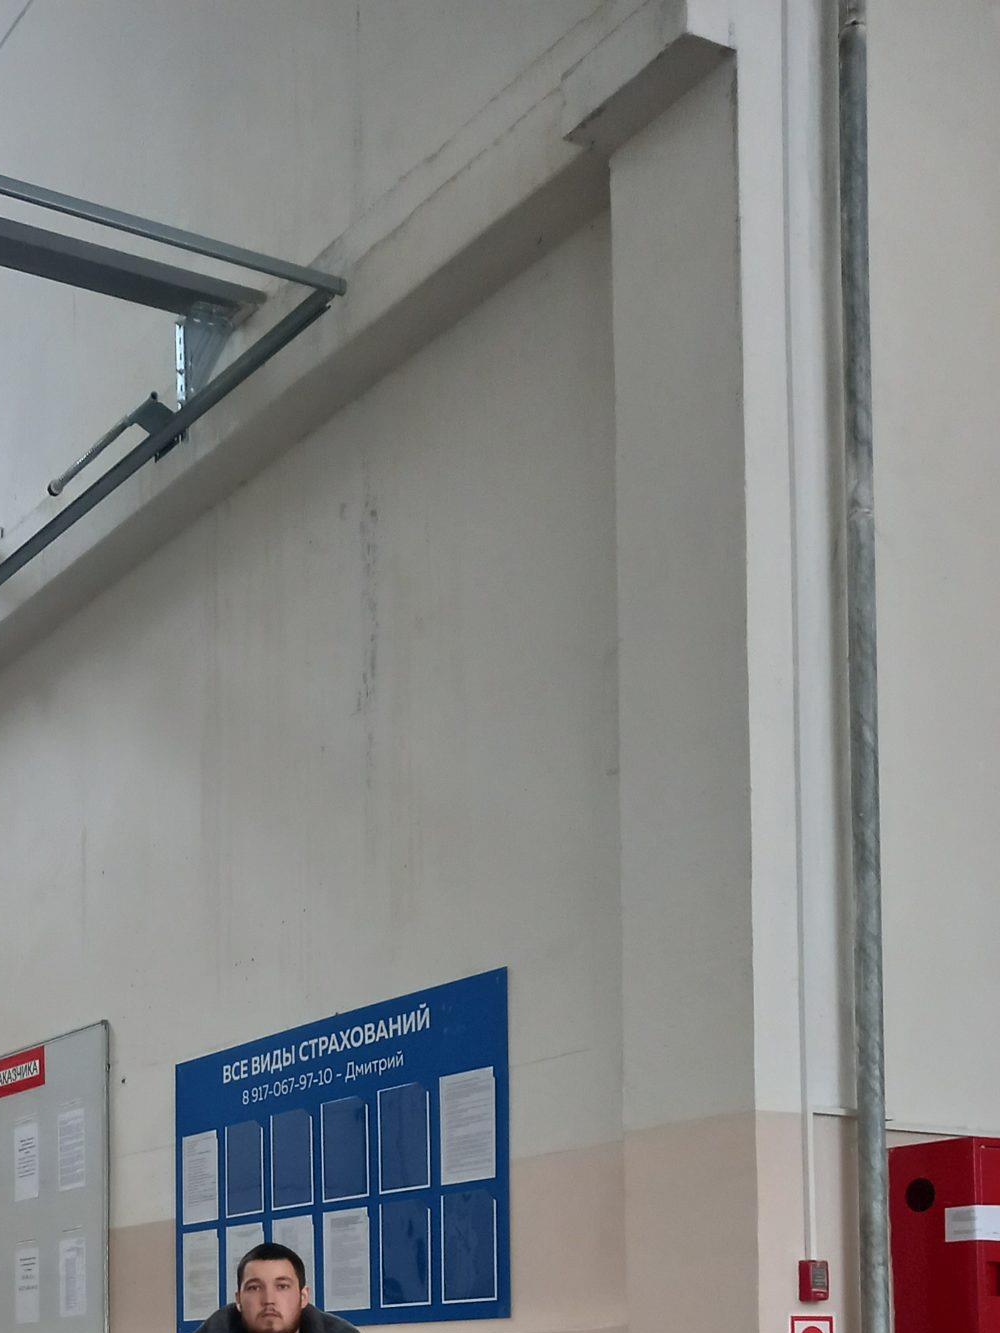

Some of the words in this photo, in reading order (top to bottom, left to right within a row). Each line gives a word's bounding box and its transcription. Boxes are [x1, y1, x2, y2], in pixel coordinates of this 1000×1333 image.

[222, 1060, 249, 1084] ВСЕ
[251, 1045, 296, 1076] ВИДЫ
[299, 1003, 431, 1062] СТРАХОВАНИЙ
[242, 1090, 250, 1105] 8
[251, 1068, 333, 1103] 917-067-97-10
[344, 1051, 404, 1083] Дмитрий
